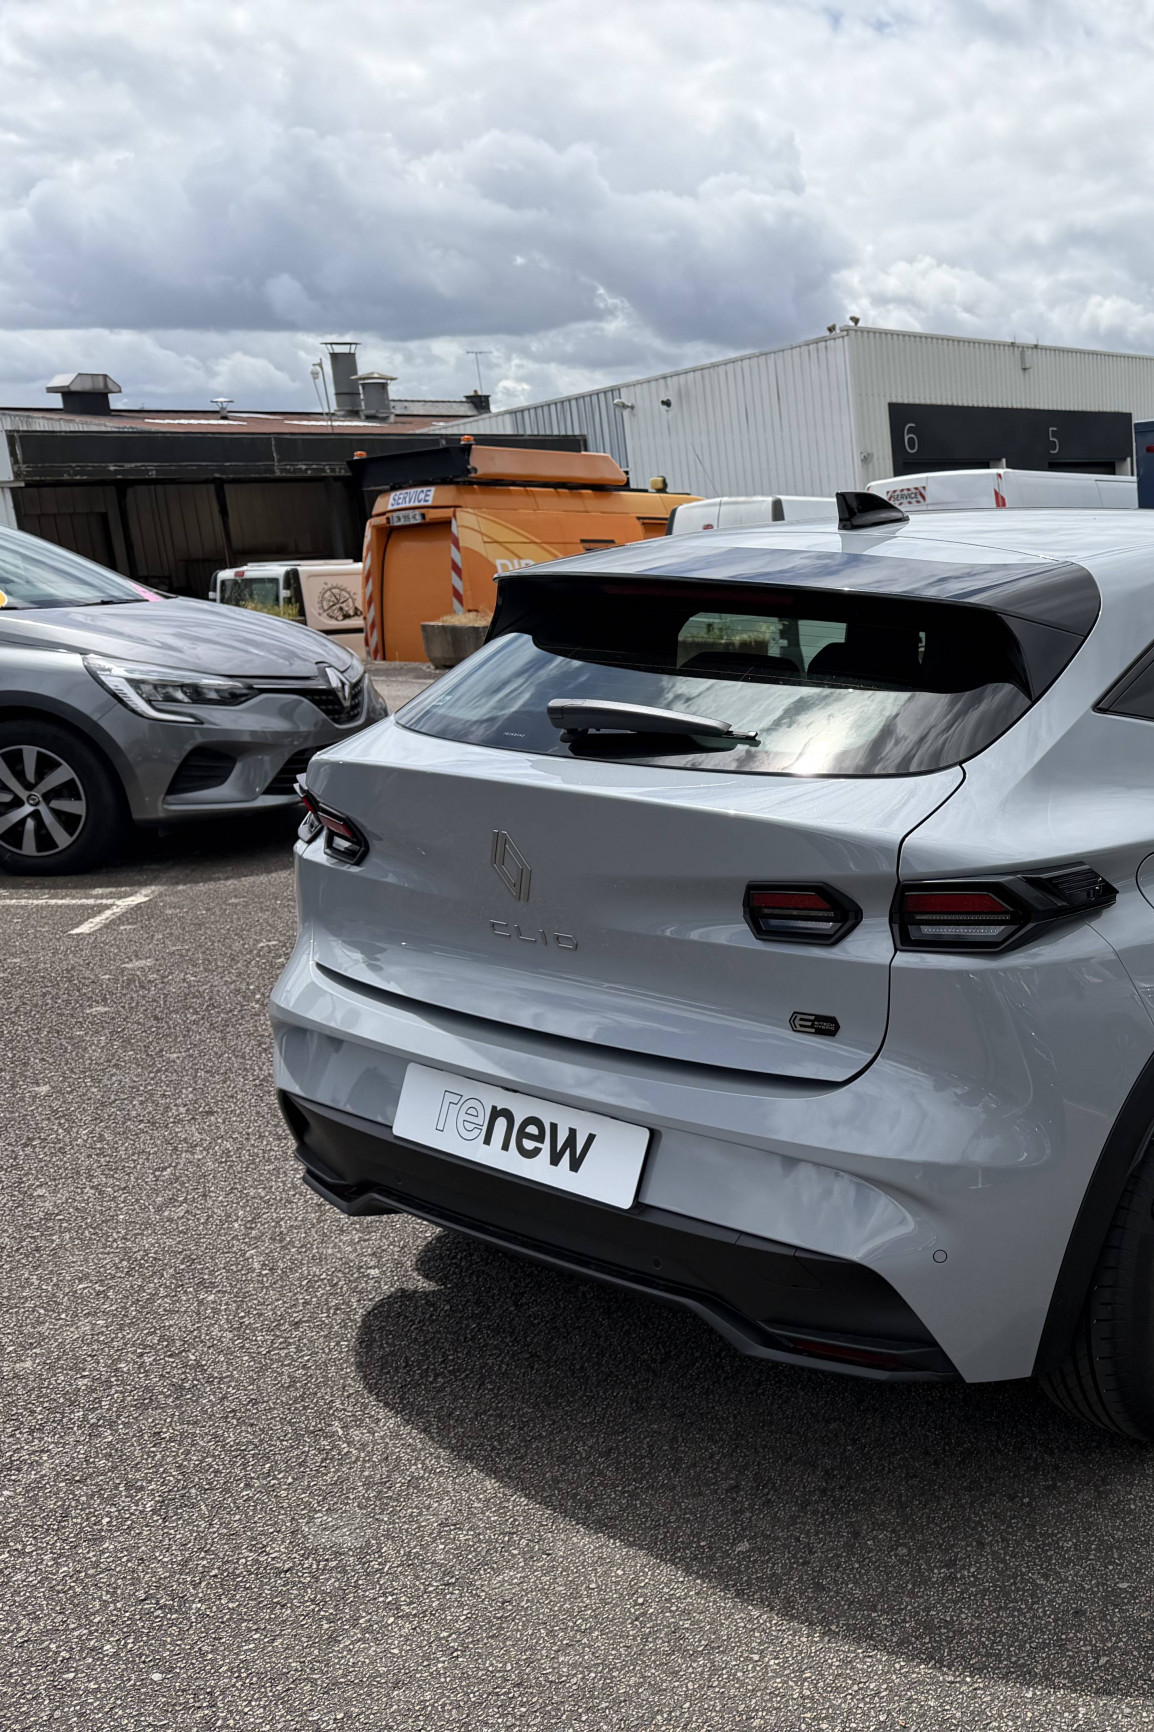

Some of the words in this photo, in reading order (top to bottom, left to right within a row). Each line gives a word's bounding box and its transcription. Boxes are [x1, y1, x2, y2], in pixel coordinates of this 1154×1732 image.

[903, 423, 919, 453] 6
[1048, 427, 1060, 454] 5
[390, 488, 432, 507] SERVICE
[892, 491, 919, 501] SERVICE
[489, 919, 579, 951] CLIO
[435, 1089, 597, 1174] renew
